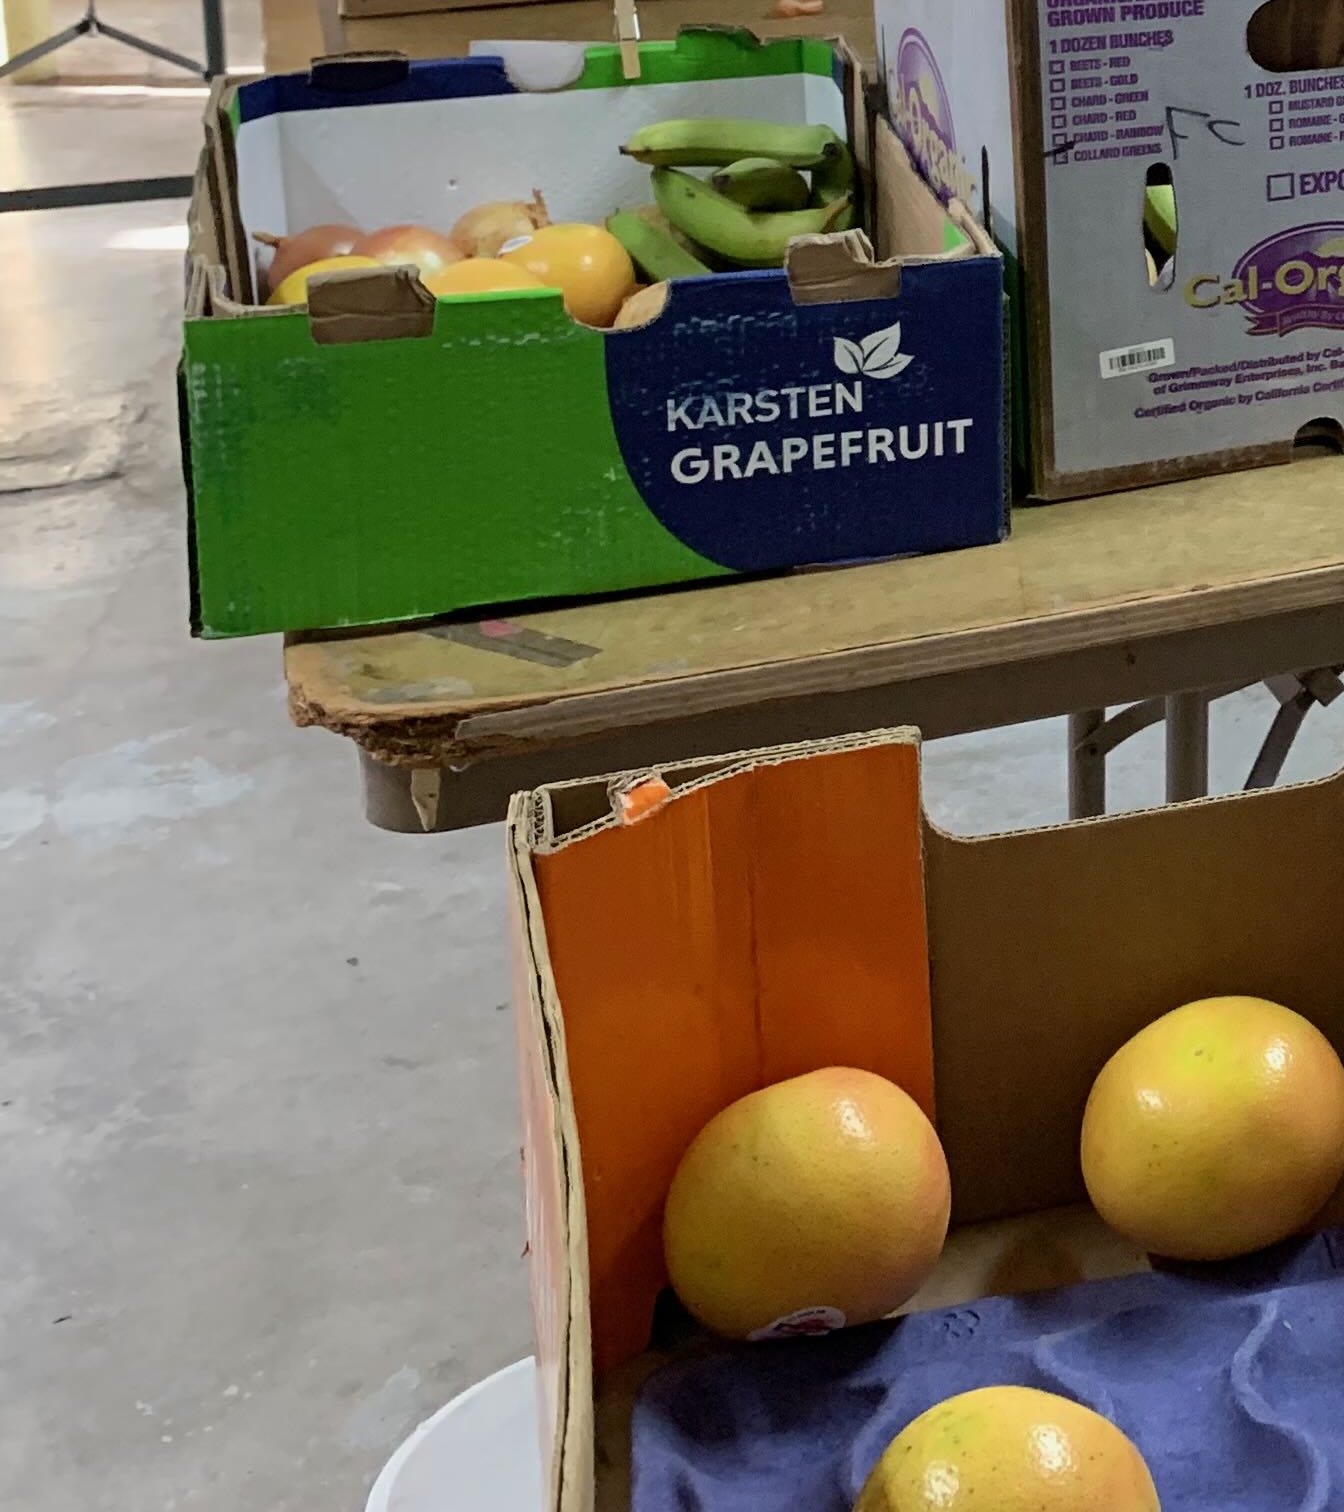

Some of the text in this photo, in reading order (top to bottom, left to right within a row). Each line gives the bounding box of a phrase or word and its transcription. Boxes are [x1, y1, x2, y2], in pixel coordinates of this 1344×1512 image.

[1047, 0, 1205, 28] GROWN PRODUCE
[1048, 29, 1175, 54] 1 DOZEN BUNCHES
[1069, 55, 1131, 72] BEETS RED
[1070, 73, 1139, 90] BEETS GOLD
[1243, 84, 1253, 99] 1
[1255, 81, 1287, 99] DOZ.
[1071, 90, 1150, 108] CHARD GREEN
[1287, 96, 1335, 112] MUSTARD
[1072, 109, 1137, 126] CHARD RED
[1288, 114, 1333, 130] ROMAINE
[1073, 124, 1165, 144] CHARD RAINBOW
[1288, 132, 1333, 148] ROMAINE
[1073, 143, 1163, 162] COLLARD GREENS
[1305, 349, 1321, 362] by
[1153, 383, 1168, 395] of
[665, 380, 864, 432] KARSTEN
[1134, 401, 1186, 419] Certified
[1188, 395, 1236, 414] Organic
[1237, 391, 1253, 405] by
[1254, 383, 1311, 402] California
[669, 417, 974, 485] GRAPEFRUIT
